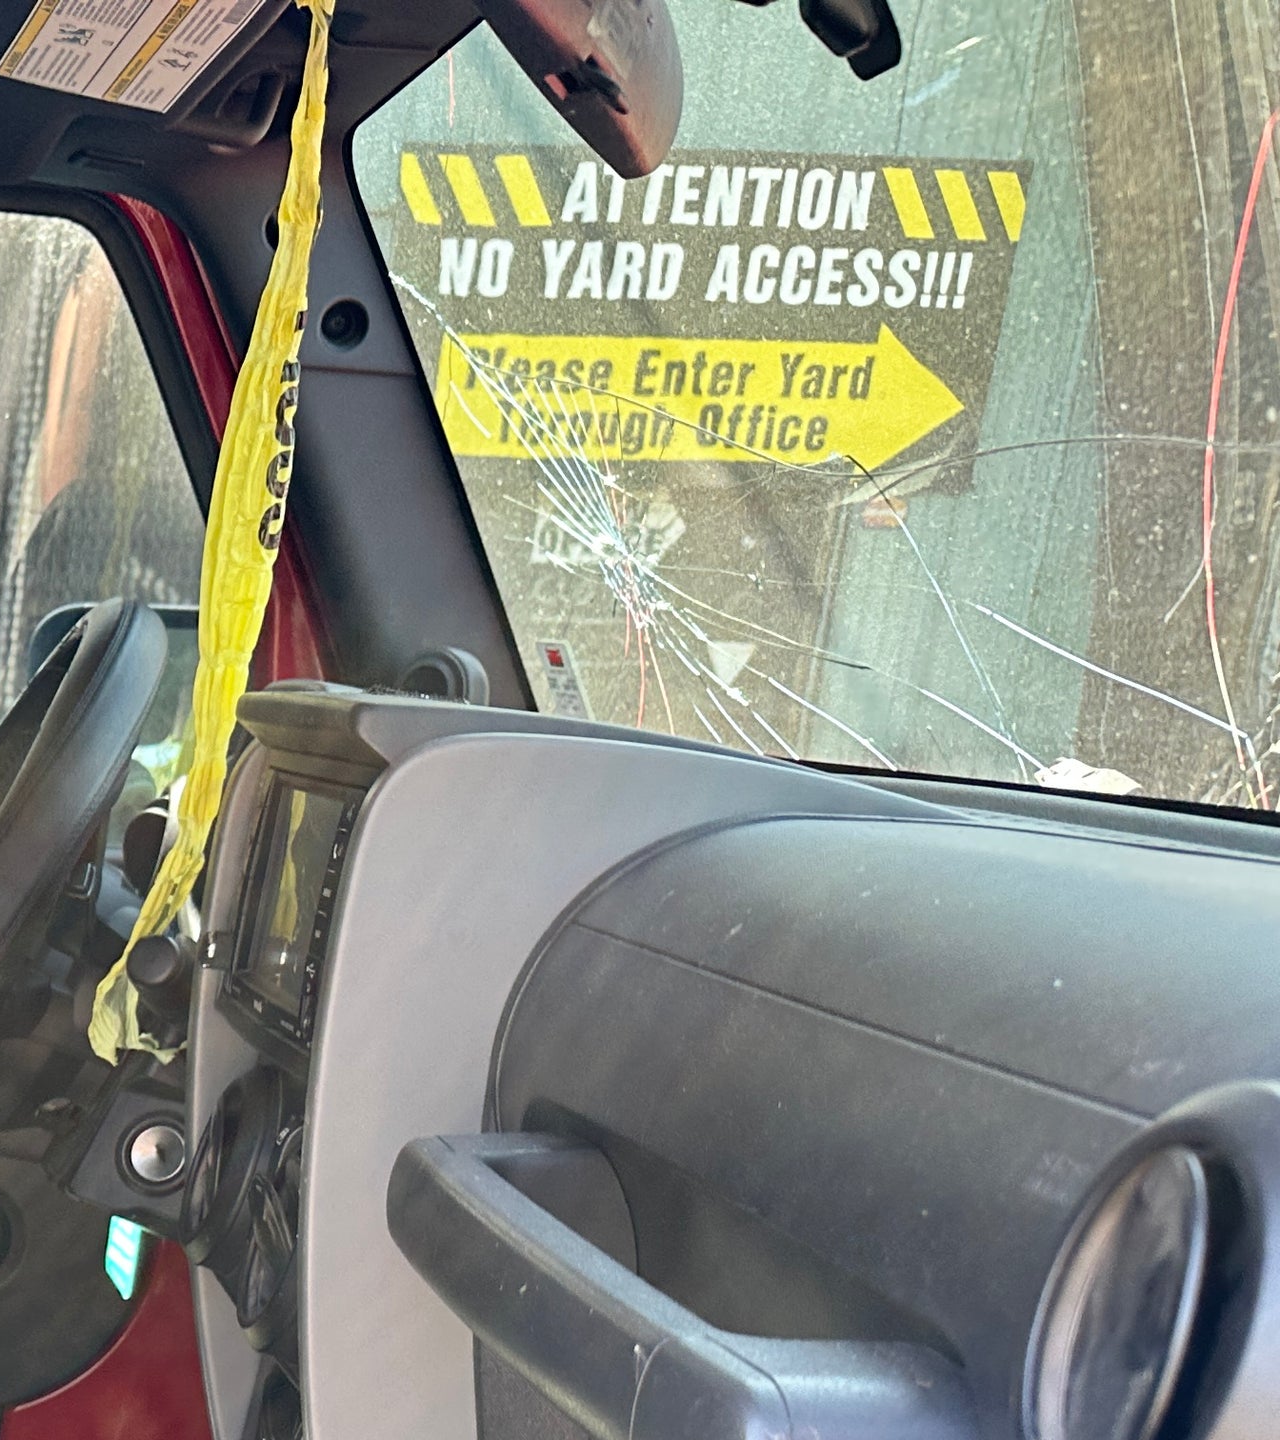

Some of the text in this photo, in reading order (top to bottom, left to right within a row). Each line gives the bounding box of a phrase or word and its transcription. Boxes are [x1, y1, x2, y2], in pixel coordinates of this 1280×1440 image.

[561, 161, 876, 231] ATTENTION
[440, 237, 974, 310] NO YARD ACCESS!!!
[464, 346, 875, 400] Please Enter Yard
[498, 399, 830, 455] Through Office
